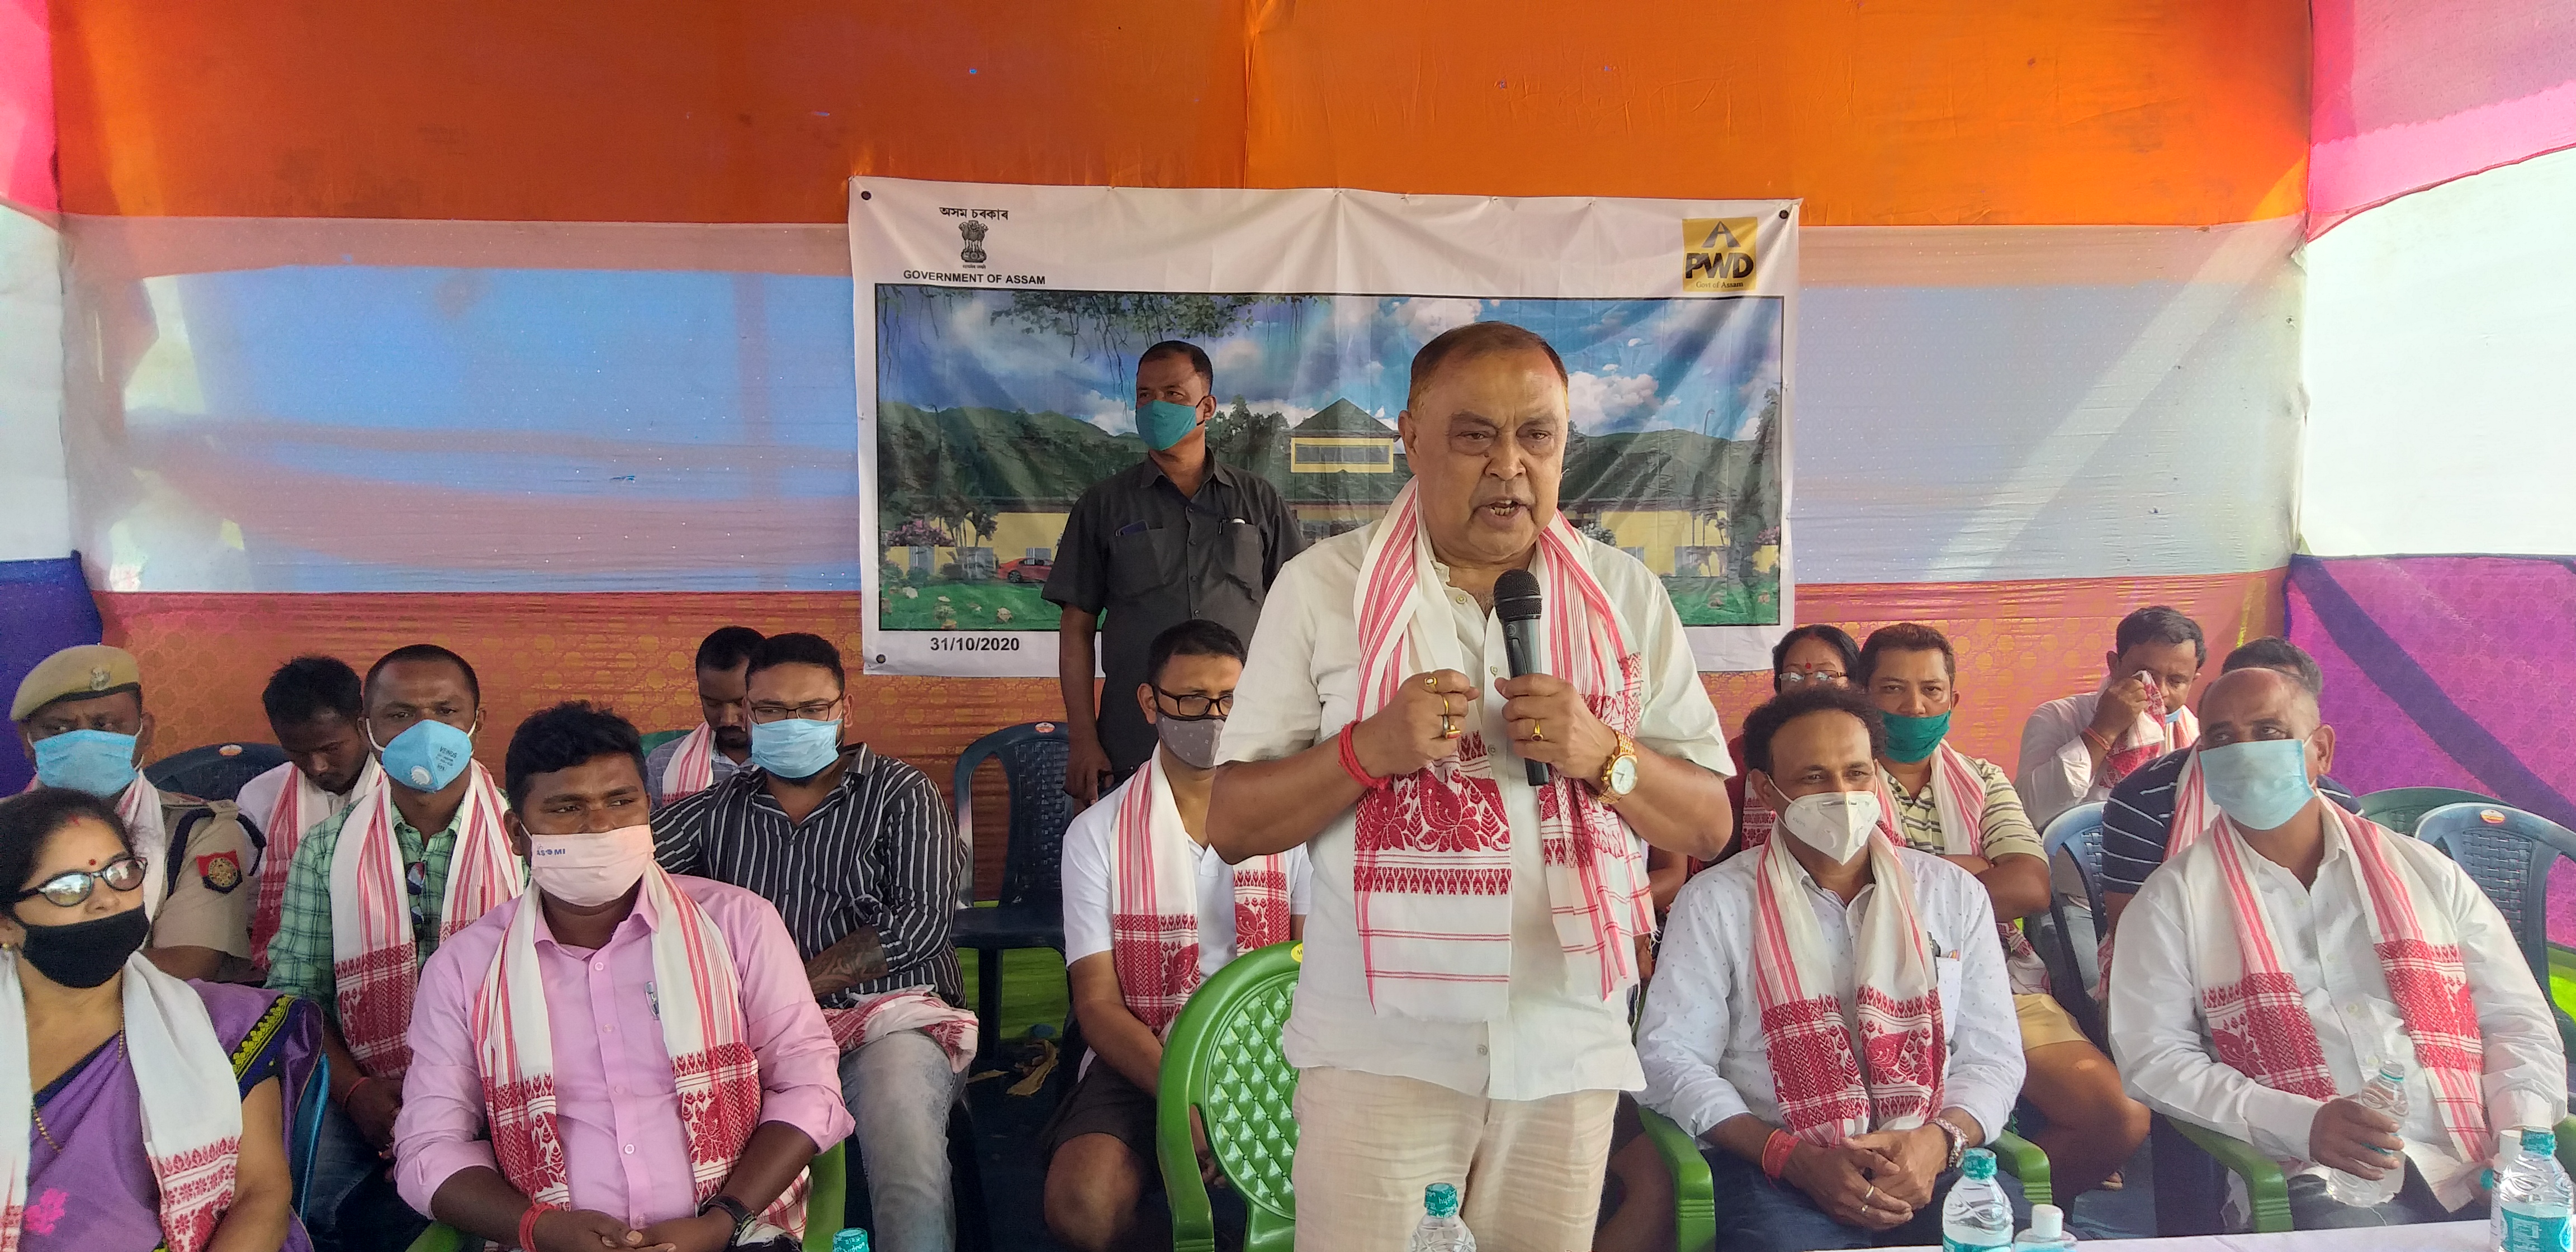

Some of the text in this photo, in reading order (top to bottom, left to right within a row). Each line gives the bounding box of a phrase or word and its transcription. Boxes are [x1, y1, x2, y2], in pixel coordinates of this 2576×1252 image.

[939, 207, 968, 219] অসম
[1685, 252, 1754, 279] PWD
[903, 270, 1045, 284] GOVERNMENT OF ASSAM
[930, 637, 1020, 651] 31/10/2020
